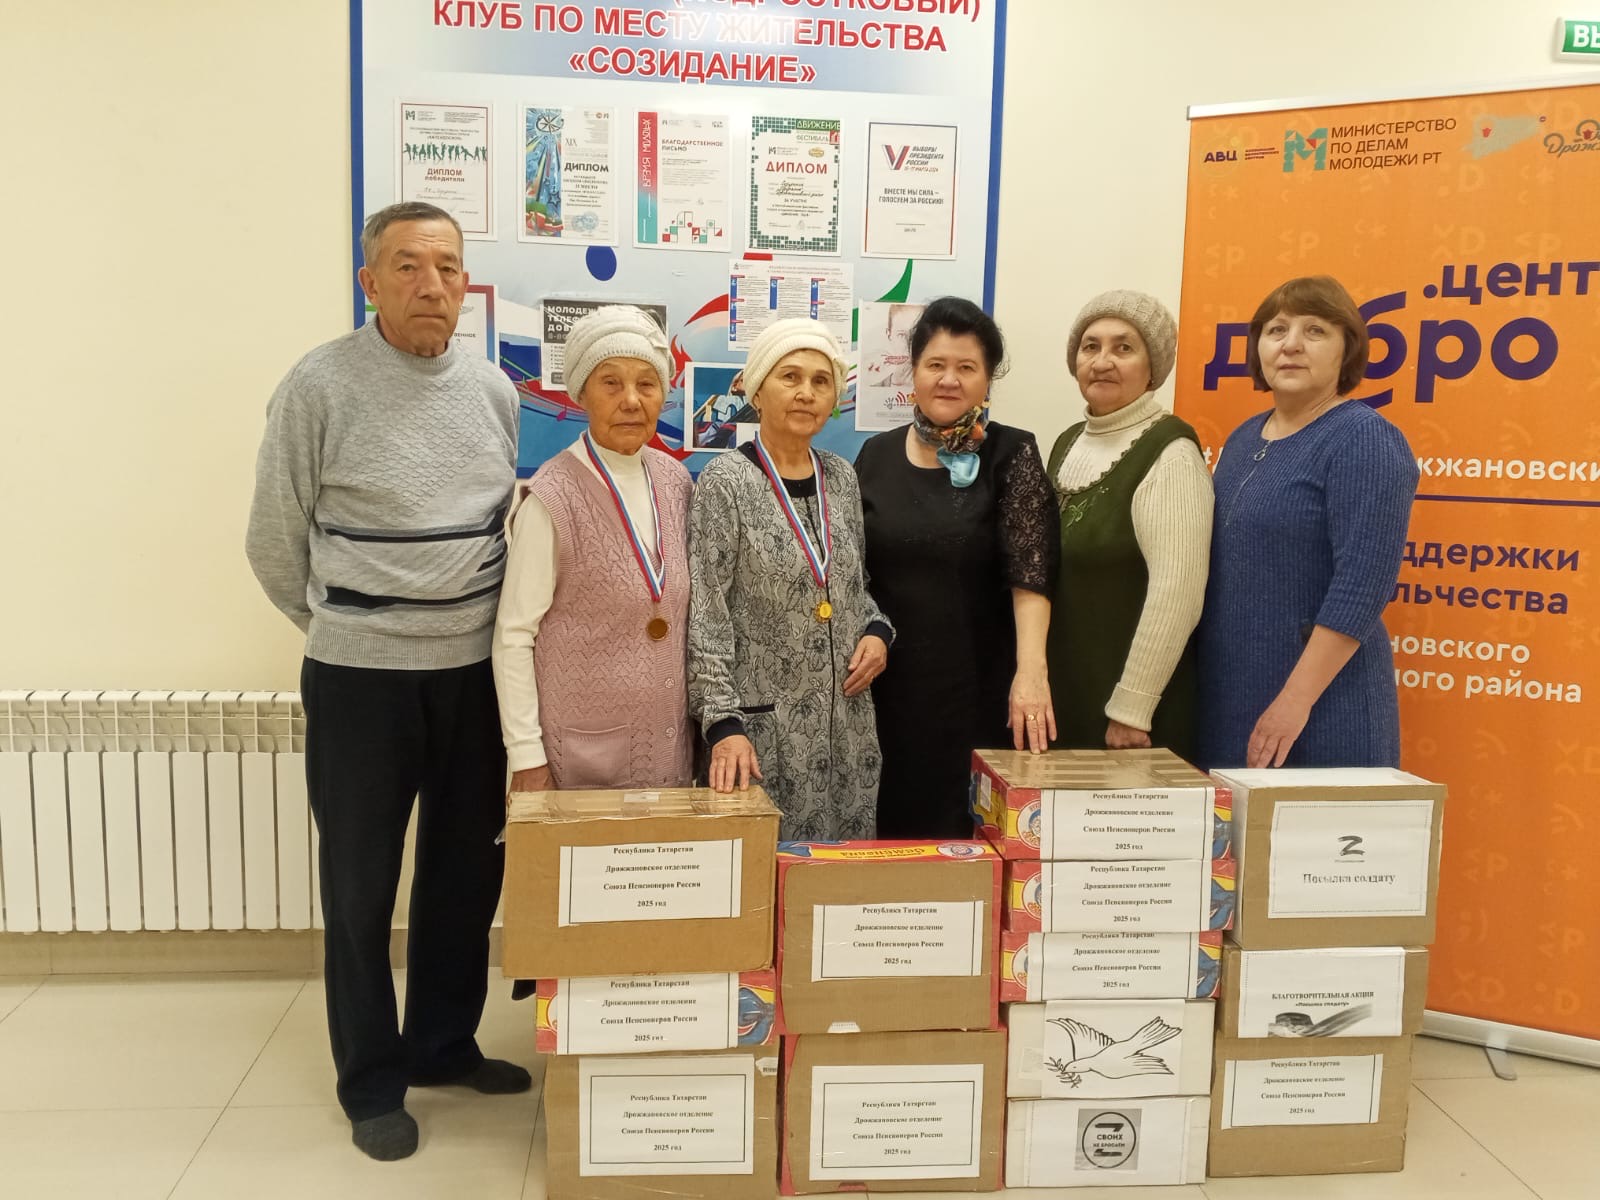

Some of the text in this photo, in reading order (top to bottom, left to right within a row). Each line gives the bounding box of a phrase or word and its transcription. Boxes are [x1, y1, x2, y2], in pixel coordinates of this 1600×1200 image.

[434, 1, 522, 30] КЛУБ
[534, 5, 583, 33] ПО
[595, 8, 709, 40] МЕСТУ
[718, 13, 947, 52] ЖИТЕЛЬСТВА
[569, 46, 816, 84] «СОЗИДАНИЕ»
[1331, 118, 1457, 139] МИНИСТЕРСТВО
[1330, 138, 1408, 154] ПО ДЕЛАМ
[1544, 132, 1600, 158] Дрож
[1204, 150, 1238, 163] АВЦ
[1329, 152, 1442, 170] МОЛОДЕЖИ РТ
[427, 168, 462, 176] ДИПЛОМ
[564, 162, 609, 172] ДИПЛОМ
[766, 161, 828, 174] ДИПЛОМ
[1203, 291, 1559, 403] дбро
[1465, 669, 1582, 703] района
[658, 846, 693, 854] Татарстан
[1303, 874, 1396, 885] Посылка солдату
[1272, 992, 1349, 1000] БЛАГОТВОРИТЕЛЬНАЯ
